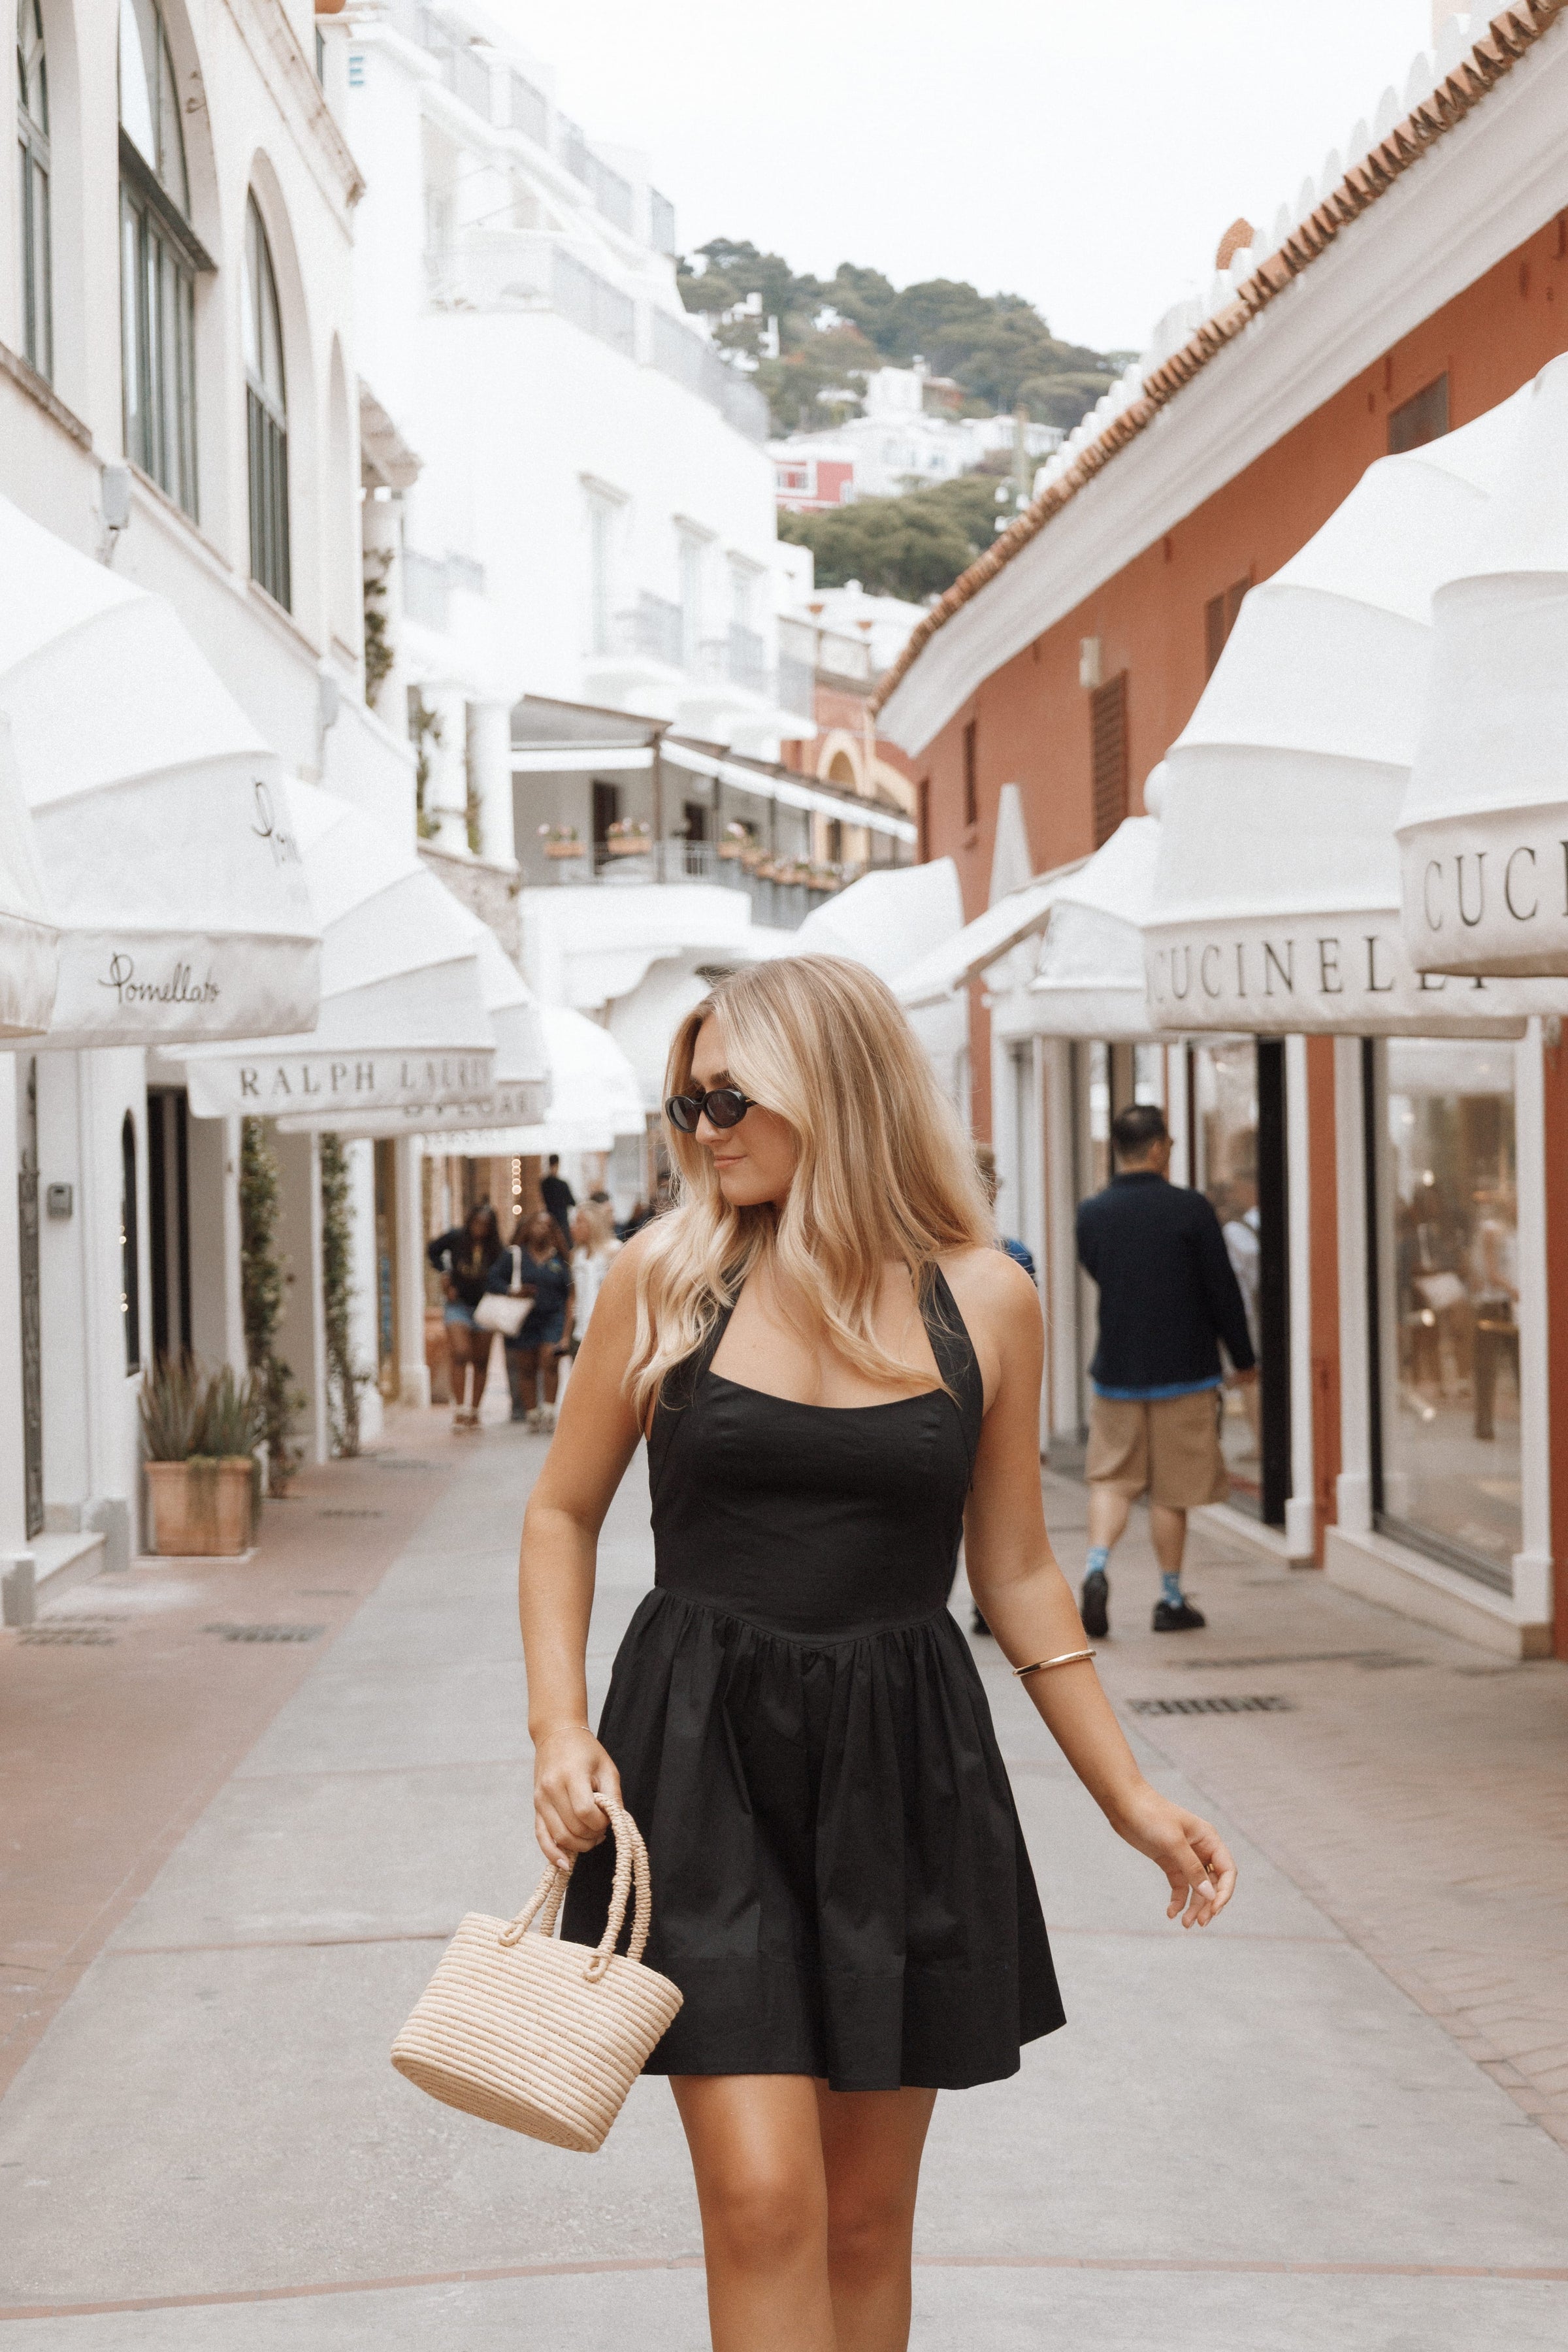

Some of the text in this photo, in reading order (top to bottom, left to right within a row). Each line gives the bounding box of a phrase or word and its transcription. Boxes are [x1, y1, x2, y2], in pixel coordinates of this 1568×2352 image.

[97, 952, 220, 1004] Pomellato
[1154, 935, 1486, 1004] CUCINEL
[240, 1060, 375, 1098] RALPH
